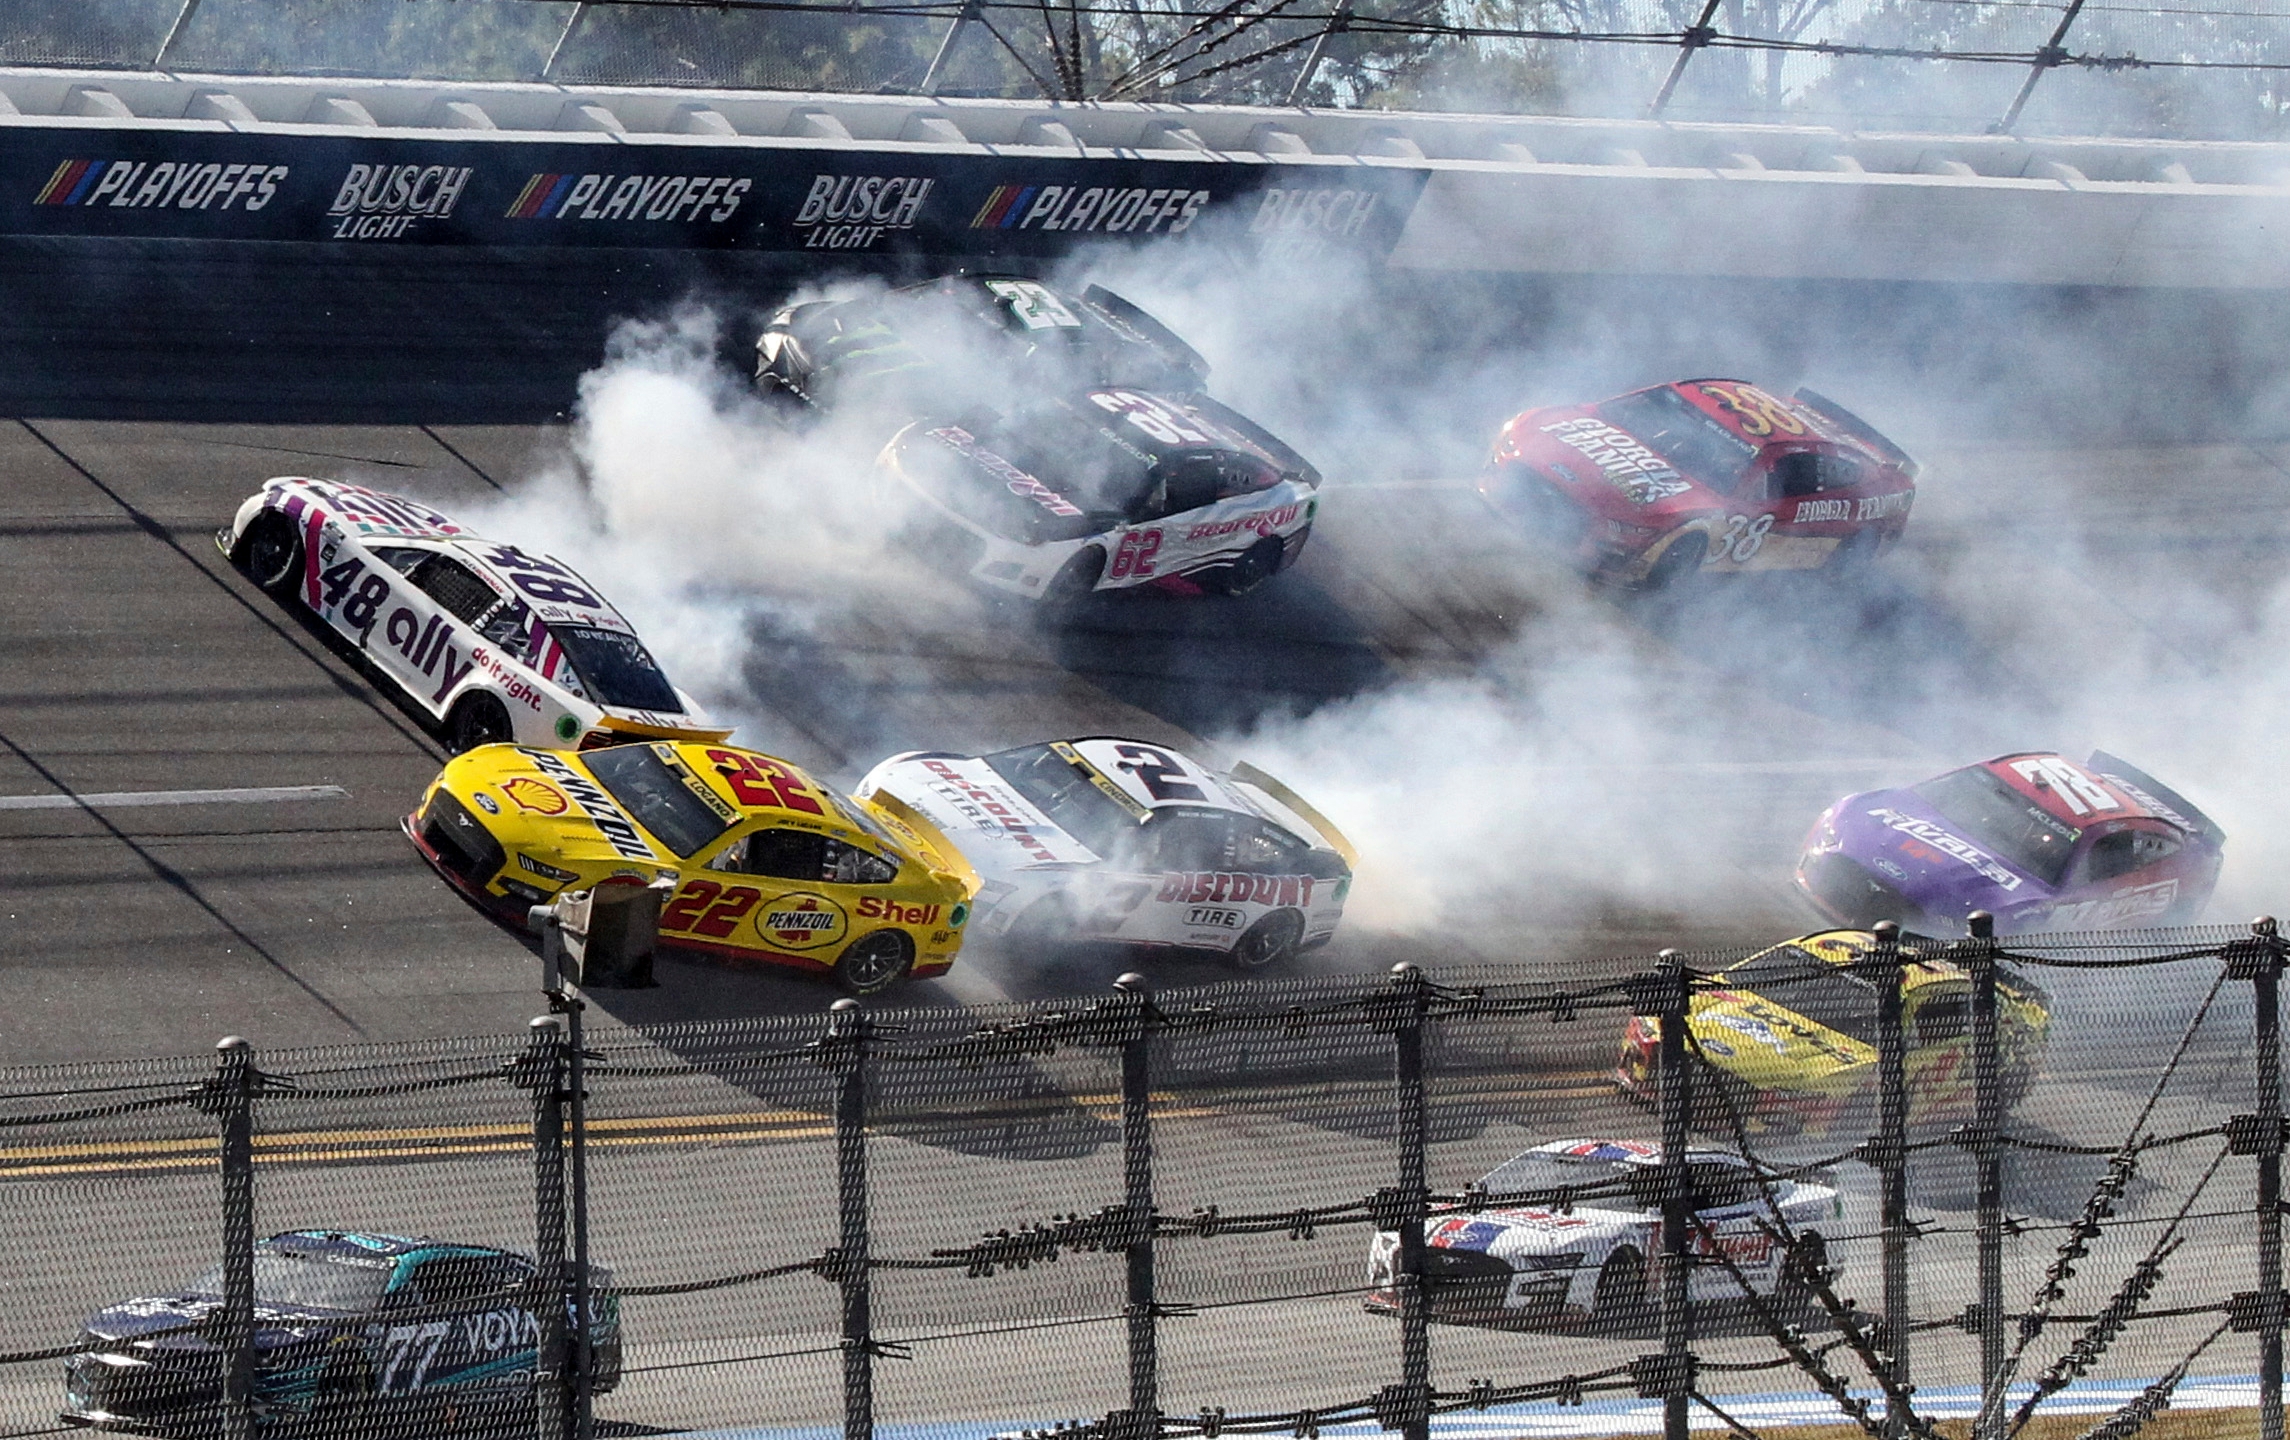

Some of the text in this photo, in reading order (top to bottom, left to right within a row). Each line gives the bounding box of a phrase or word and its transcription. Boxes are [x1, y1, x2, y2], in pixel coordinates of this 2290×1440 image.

[84, 161, 289, 211] PLAYOFFS
[326, 163, 474, 218] BUSCH
[555, 174, 752, 222] PLAYOFFS
[792, 175, 936, 229] BUSCH
[1019, 186, 1210, 233] PLAYOFFS
[1246, 188, 1379, 236] BUSCH
[333, 215, 418, 239] LIGHT
[804, 225, 885, 248] LIGHT
[985, 280, 1084, 331] 23
[1700, 386, 1805, 437] 38
[1539, 420, 1660, 503] PEANUTS
[1571, 417, 1693, 497] GEORGIA
[1793, 499, 1852, 524] GEORGIA
[1109, 527, 1164, 580] 62
[1702, 513, 1776, 565] 38
[320, 557, 390, 630] 48
[482, 546, 603, 609] 48
[386, 607, 475, 706] ally
[471, 646, 489, 667] do
[489, 661, 503, 680] it
[501, 672, 542, 713] right.
[690, 780, 730, 818] LOGANO
[705, 749, 825, 816] 22
[1099, 780, 1141, 815] CINDRIC
[1115, 745, 1209, 801] 2
[2009, 757, 2120, 816] 78
[514, 746, 658, 861] PENNZOIL
[921, 760, 1058, 861] DISCOUNT
[938, 787, 996, 831] TIRE
[659, 879, 762, 938] 22
[856, 896, 940, 925] Shell
[1156, 871, 1316, 907] DISCOUNT
[766, 911, 836, 931] PENNZOIL
[1190, 909, 1238, 927] TIRE
[381, 1320, 450, 1393] 77
